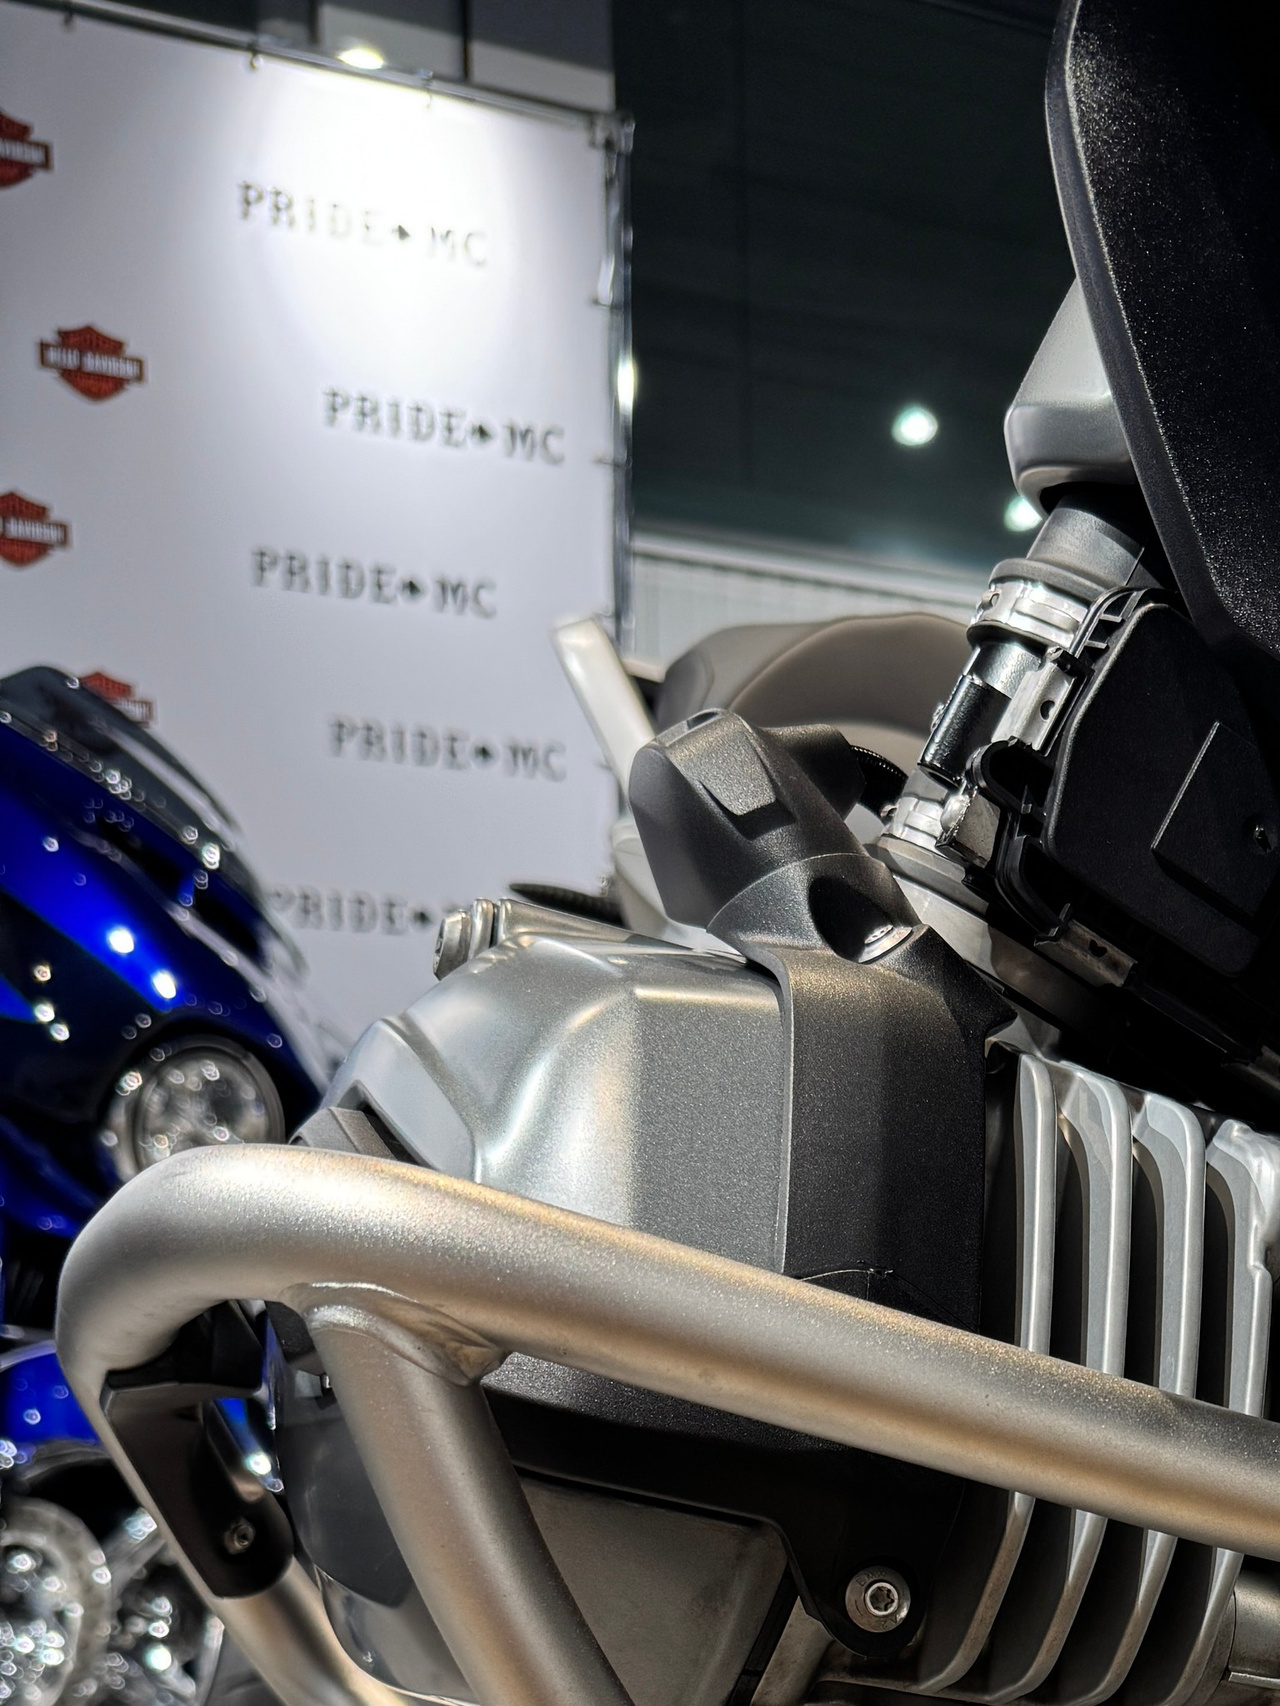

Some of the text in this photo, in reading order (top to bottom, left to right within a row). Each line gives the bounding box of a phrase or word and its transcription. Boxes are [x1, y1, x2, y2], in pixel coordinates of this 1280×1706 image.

[238, 180, 487, 268] PRIDE MC
[323, 385, 565, 467] PRIDE MC
[251, 546, 497, 620] PRIDE MC
[327, 716, 567, 783] PRIDE MC
[267, 884, 410, 936] PRIDE
